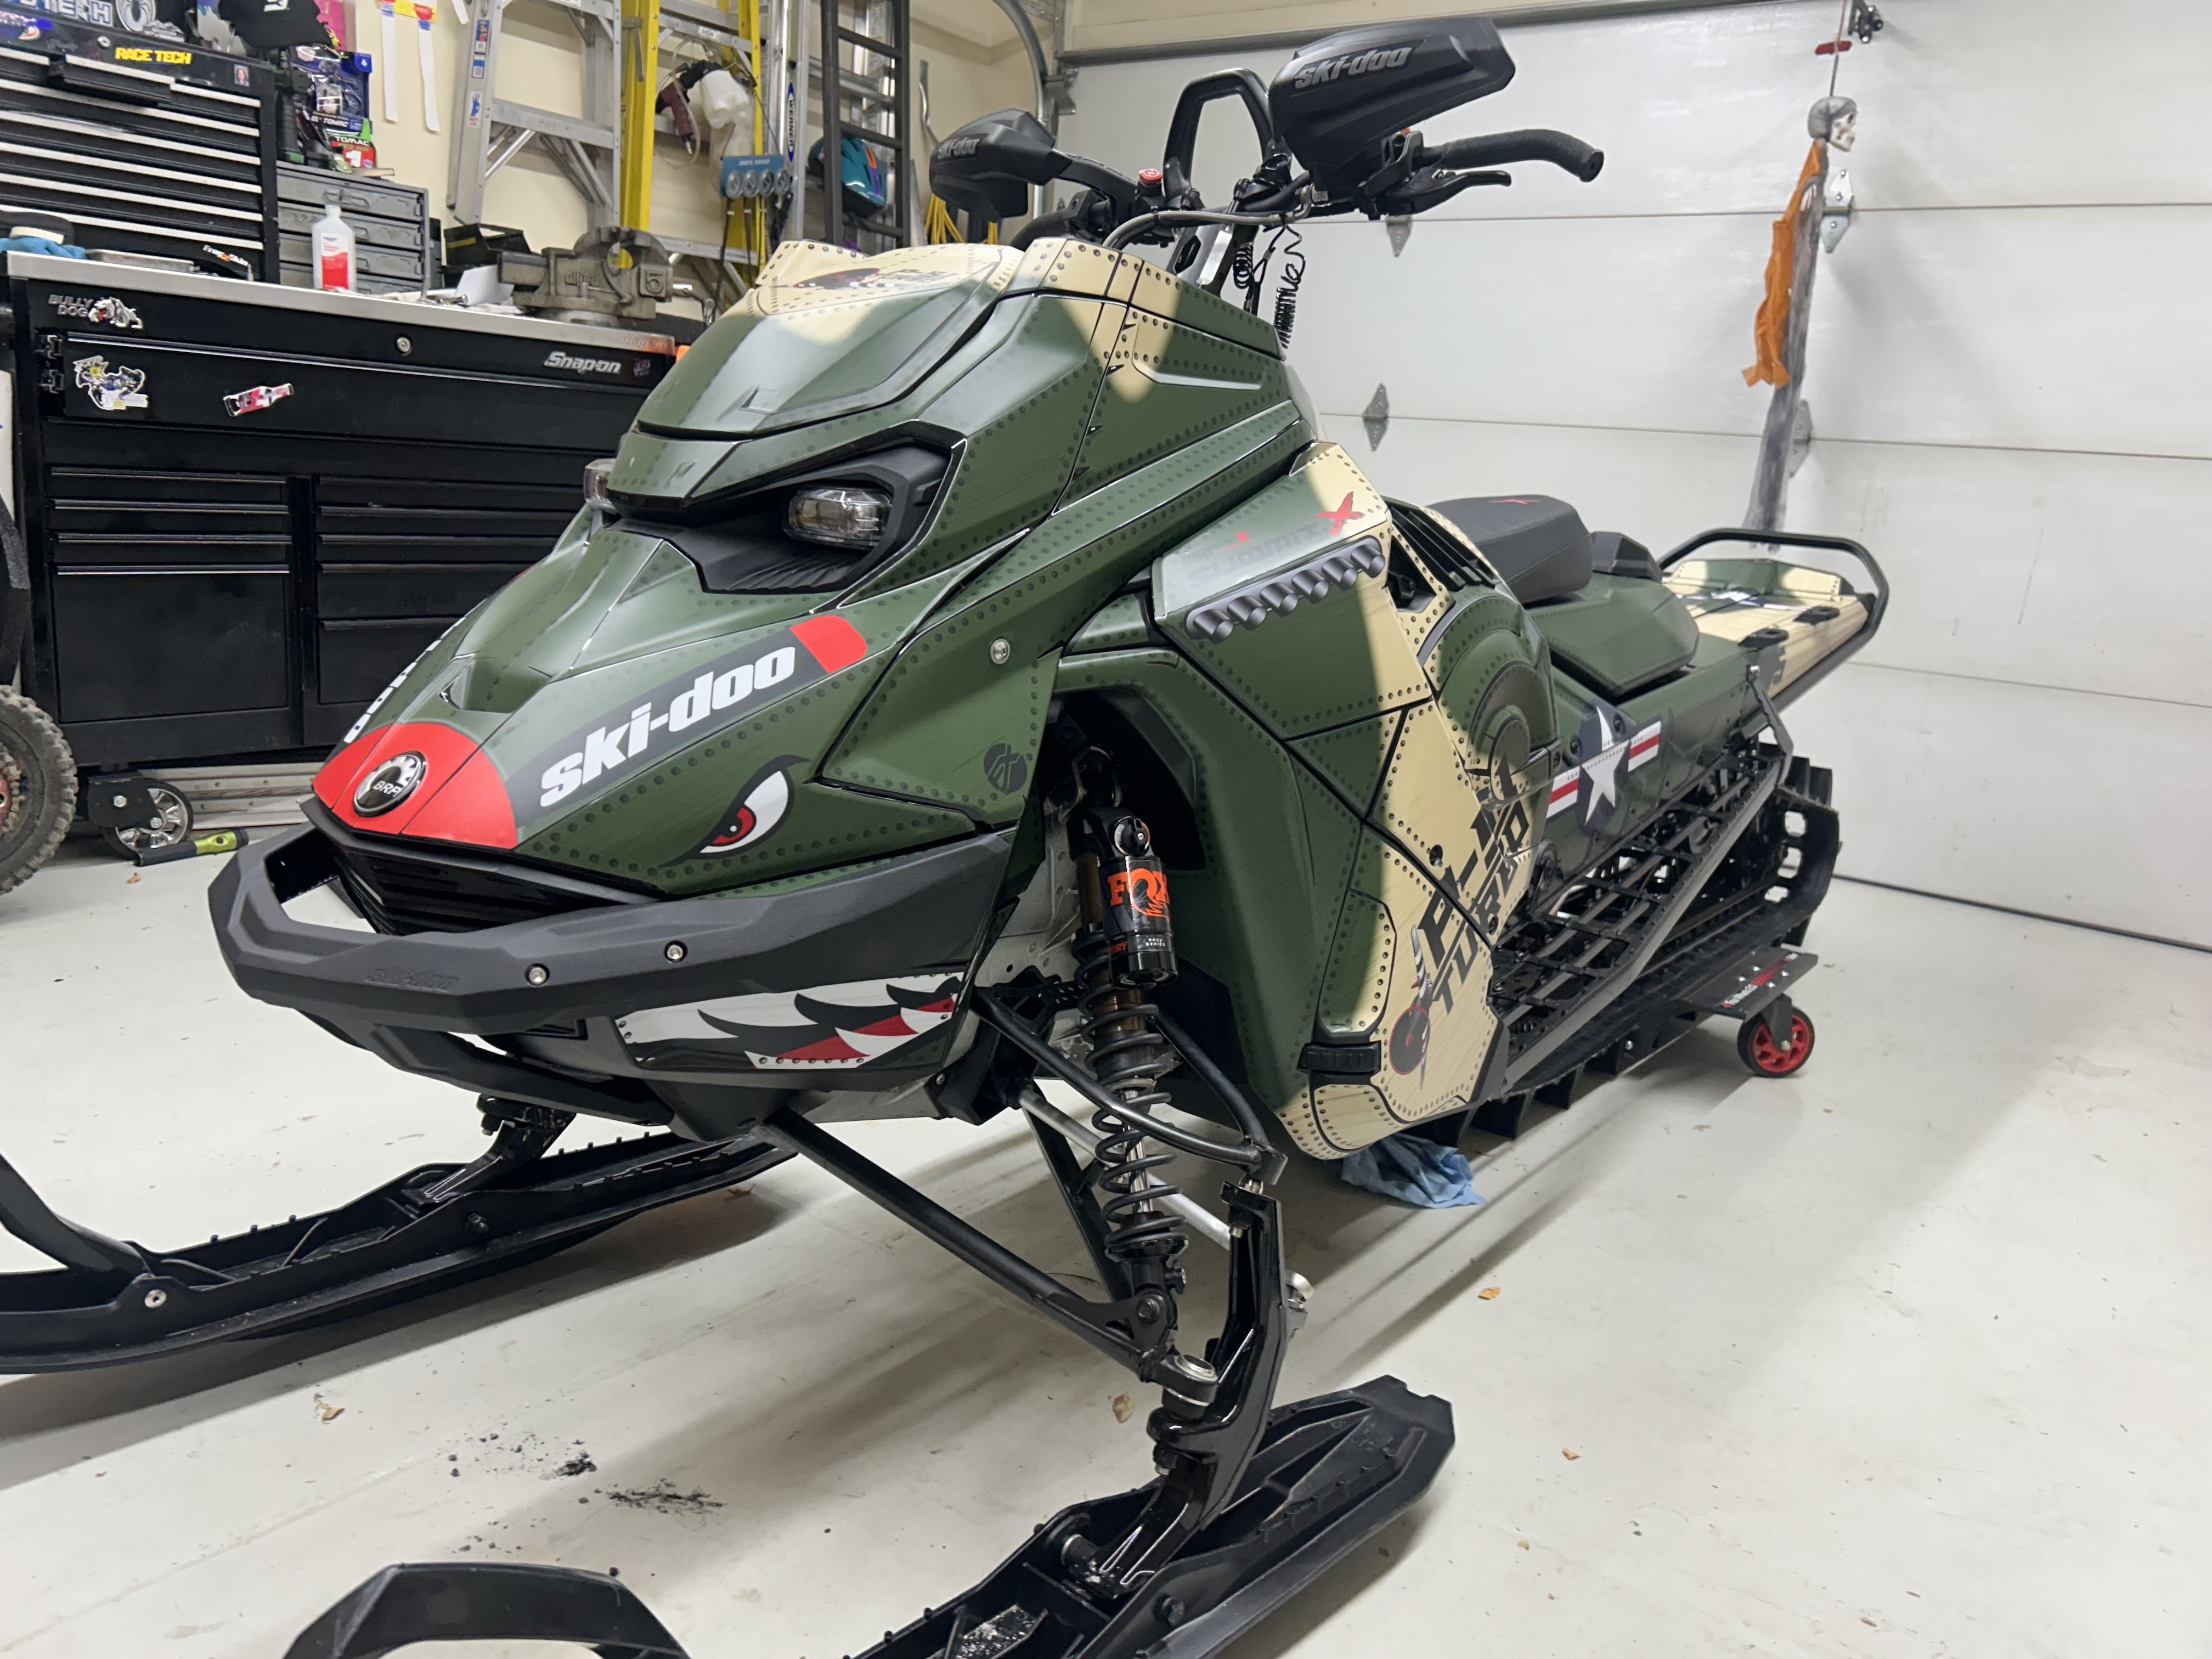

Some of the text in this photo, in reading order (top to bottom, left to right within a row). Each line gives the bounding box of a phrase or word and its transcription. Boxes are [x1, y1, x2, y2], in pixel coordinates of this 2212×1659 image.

[115, 47, 191, 65] RACE TECH
[335, 136, 370, 146] TOMAC
[646, 271, 664, 294] 5
[48, 295, 94, 308] BULLY
[58, 305, 89, 318] DOG
[373, 781, 402, 798] BRP
[1108, 868, 1170, 922] FOX
